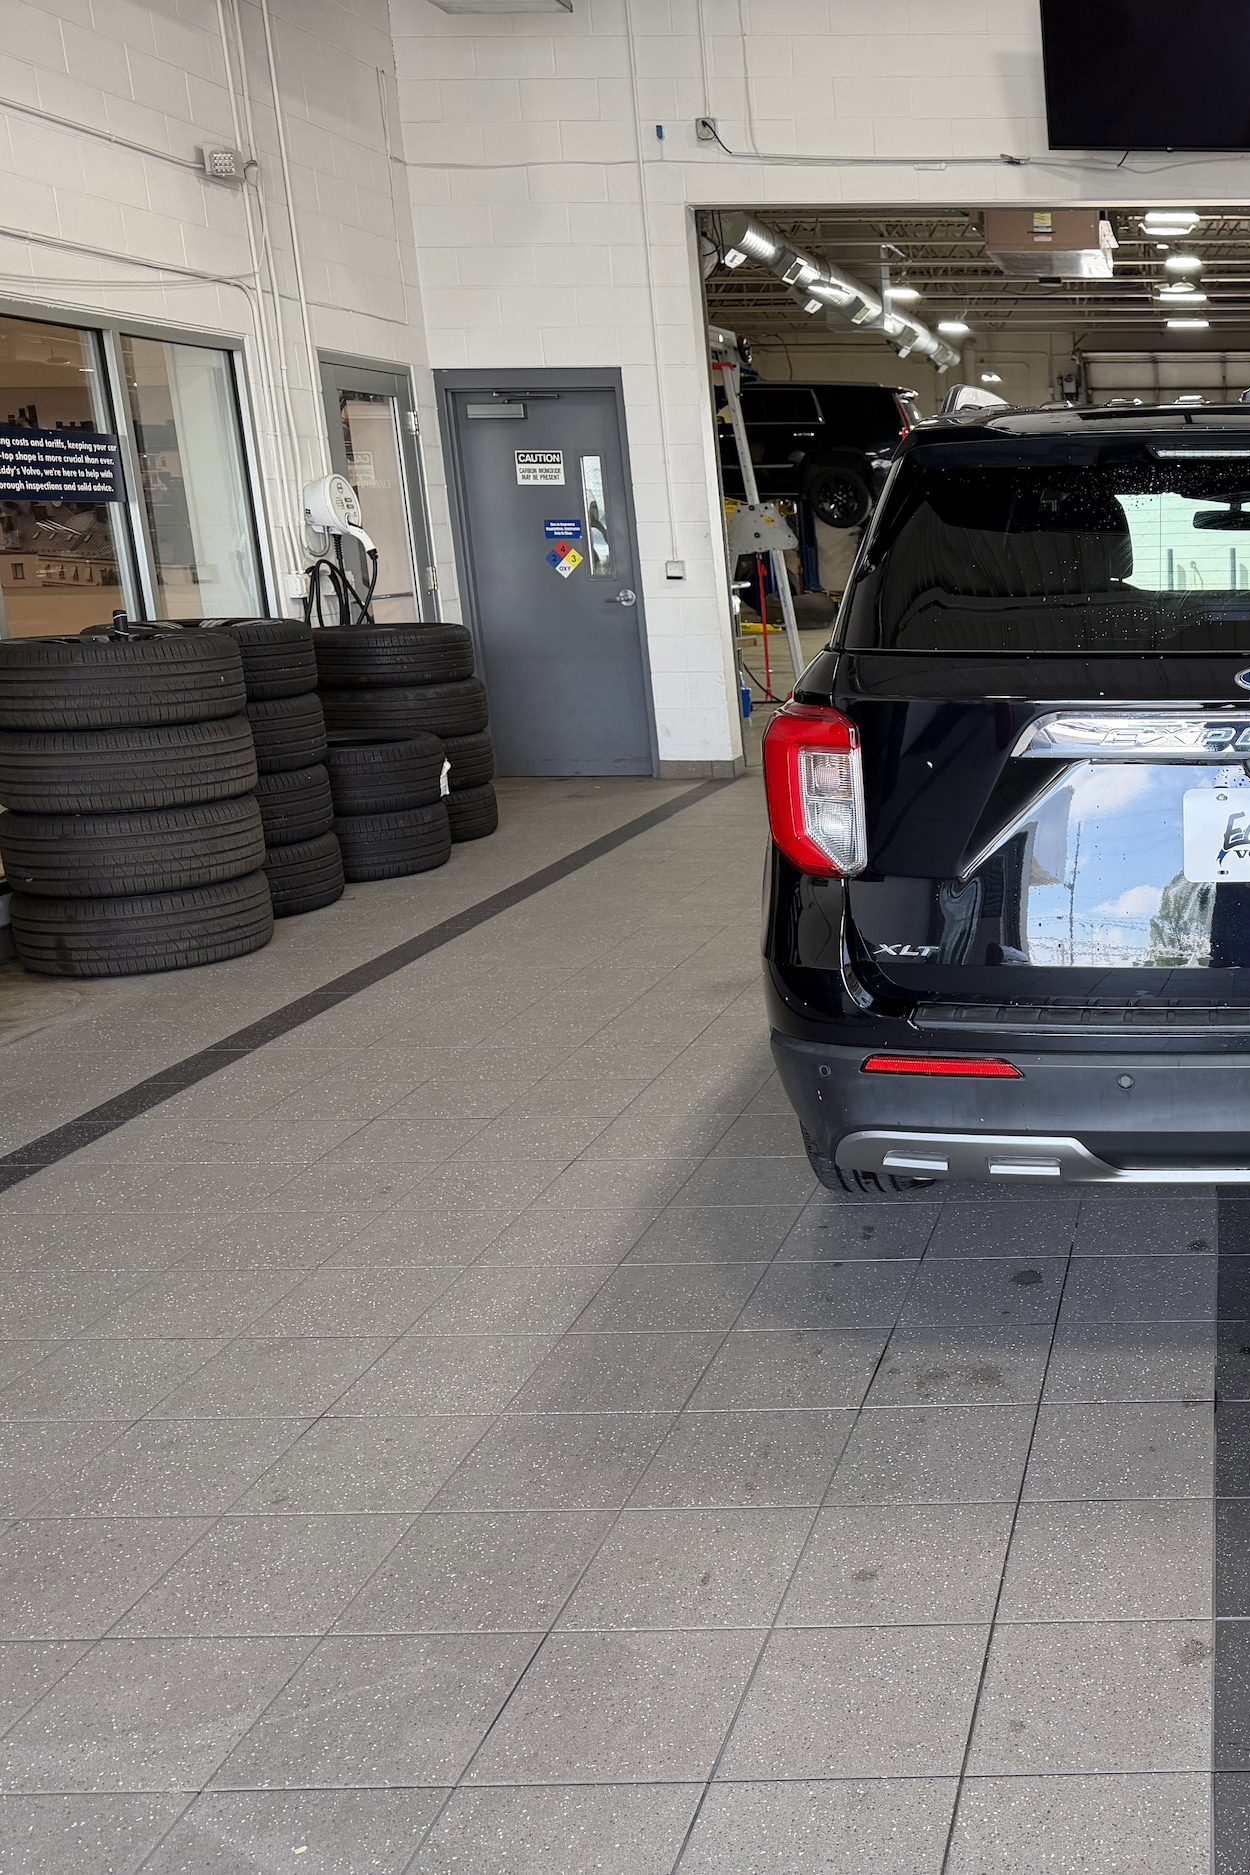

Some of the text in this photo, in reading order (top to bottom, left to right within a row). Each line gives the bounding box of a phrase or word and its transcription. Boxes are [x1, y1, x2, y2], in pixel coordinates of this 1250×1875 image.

[12, 438, 29, 446] costs
[30, 438, 44, 447] and
[45, 439, 66, 450] tariffs,
[67, 440, 92, 452] keeping
[93, 443, 106, 452] your
[15, 451, 36, 463] shape
[37, 452, 44, 461] is
[63, 454, 84, 463] crucial
[85, 455, 99, 464] than
[518, 454, 560, 462] CAUTION
[21, 466, 43, 477] Volvo,
[43, 468, 61, 476] we're
[62, 467, 77, 477] here
[77, 469, 85, 477] to
[85, 468, 99, 479] help
[100, 470, 113, 478] with
[25, 480, 62, 492] inspections
[63, 482, 76, 491] and
[77, 482, 92, 491] solid
[93, 483, 114, 492] advice.
[552, 554, 557, 562] 2
[571, 554, 577, 562] 3
[873, 944, 939, 957] XLT
